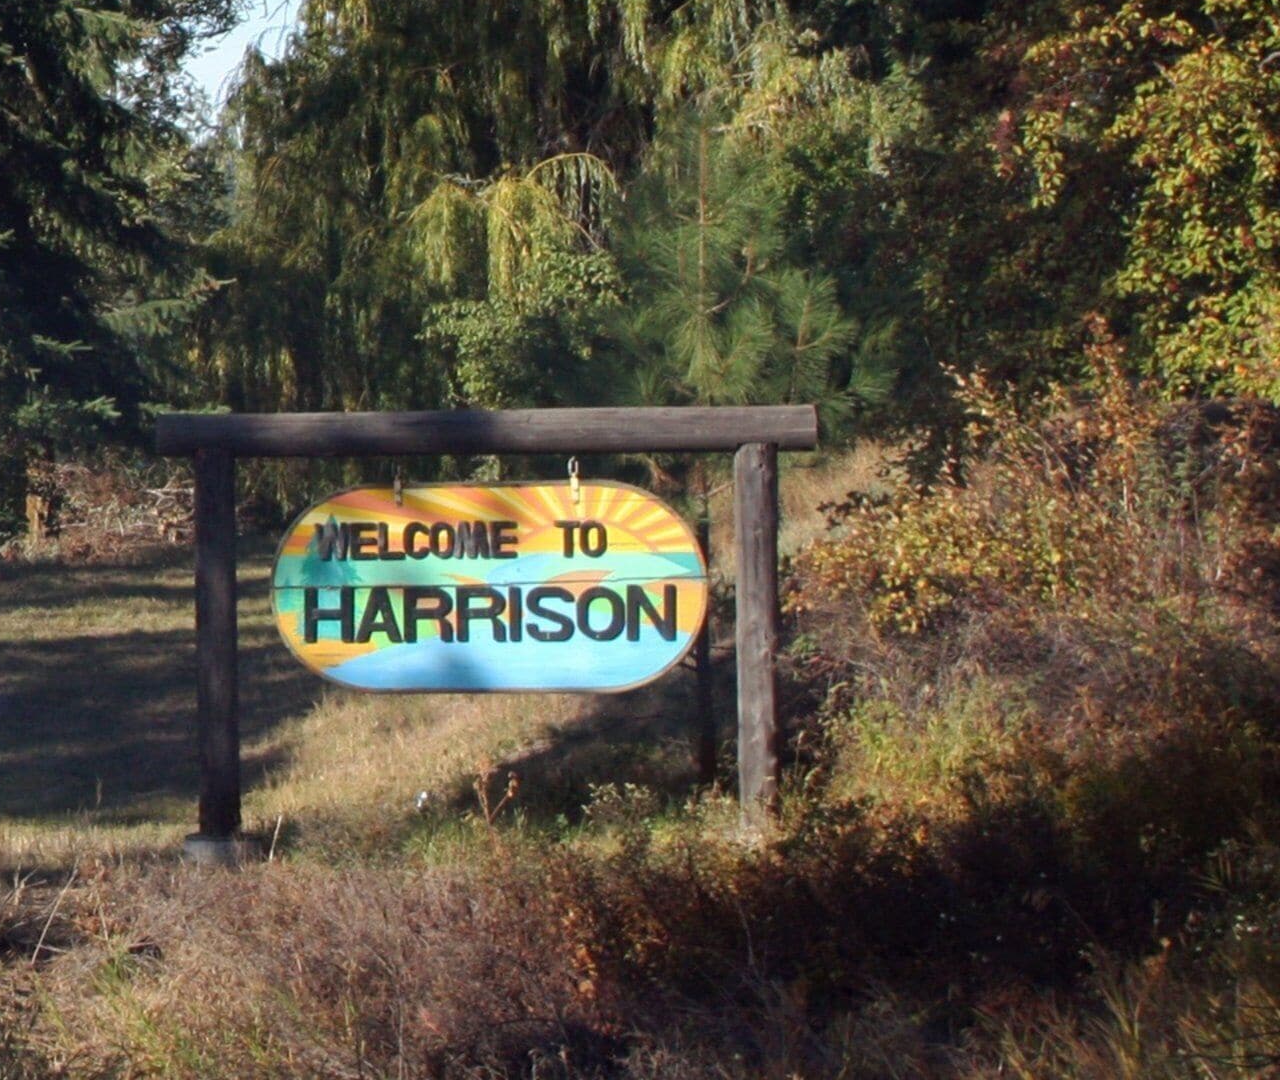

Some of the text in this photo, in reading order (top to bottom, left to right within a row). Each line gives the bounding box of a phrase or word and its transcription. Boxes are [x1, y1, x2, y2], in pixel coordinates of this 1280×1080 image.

[315, 519, 608, 561] WELCOME TO
[303, 584, 677, 644] HARRISON
